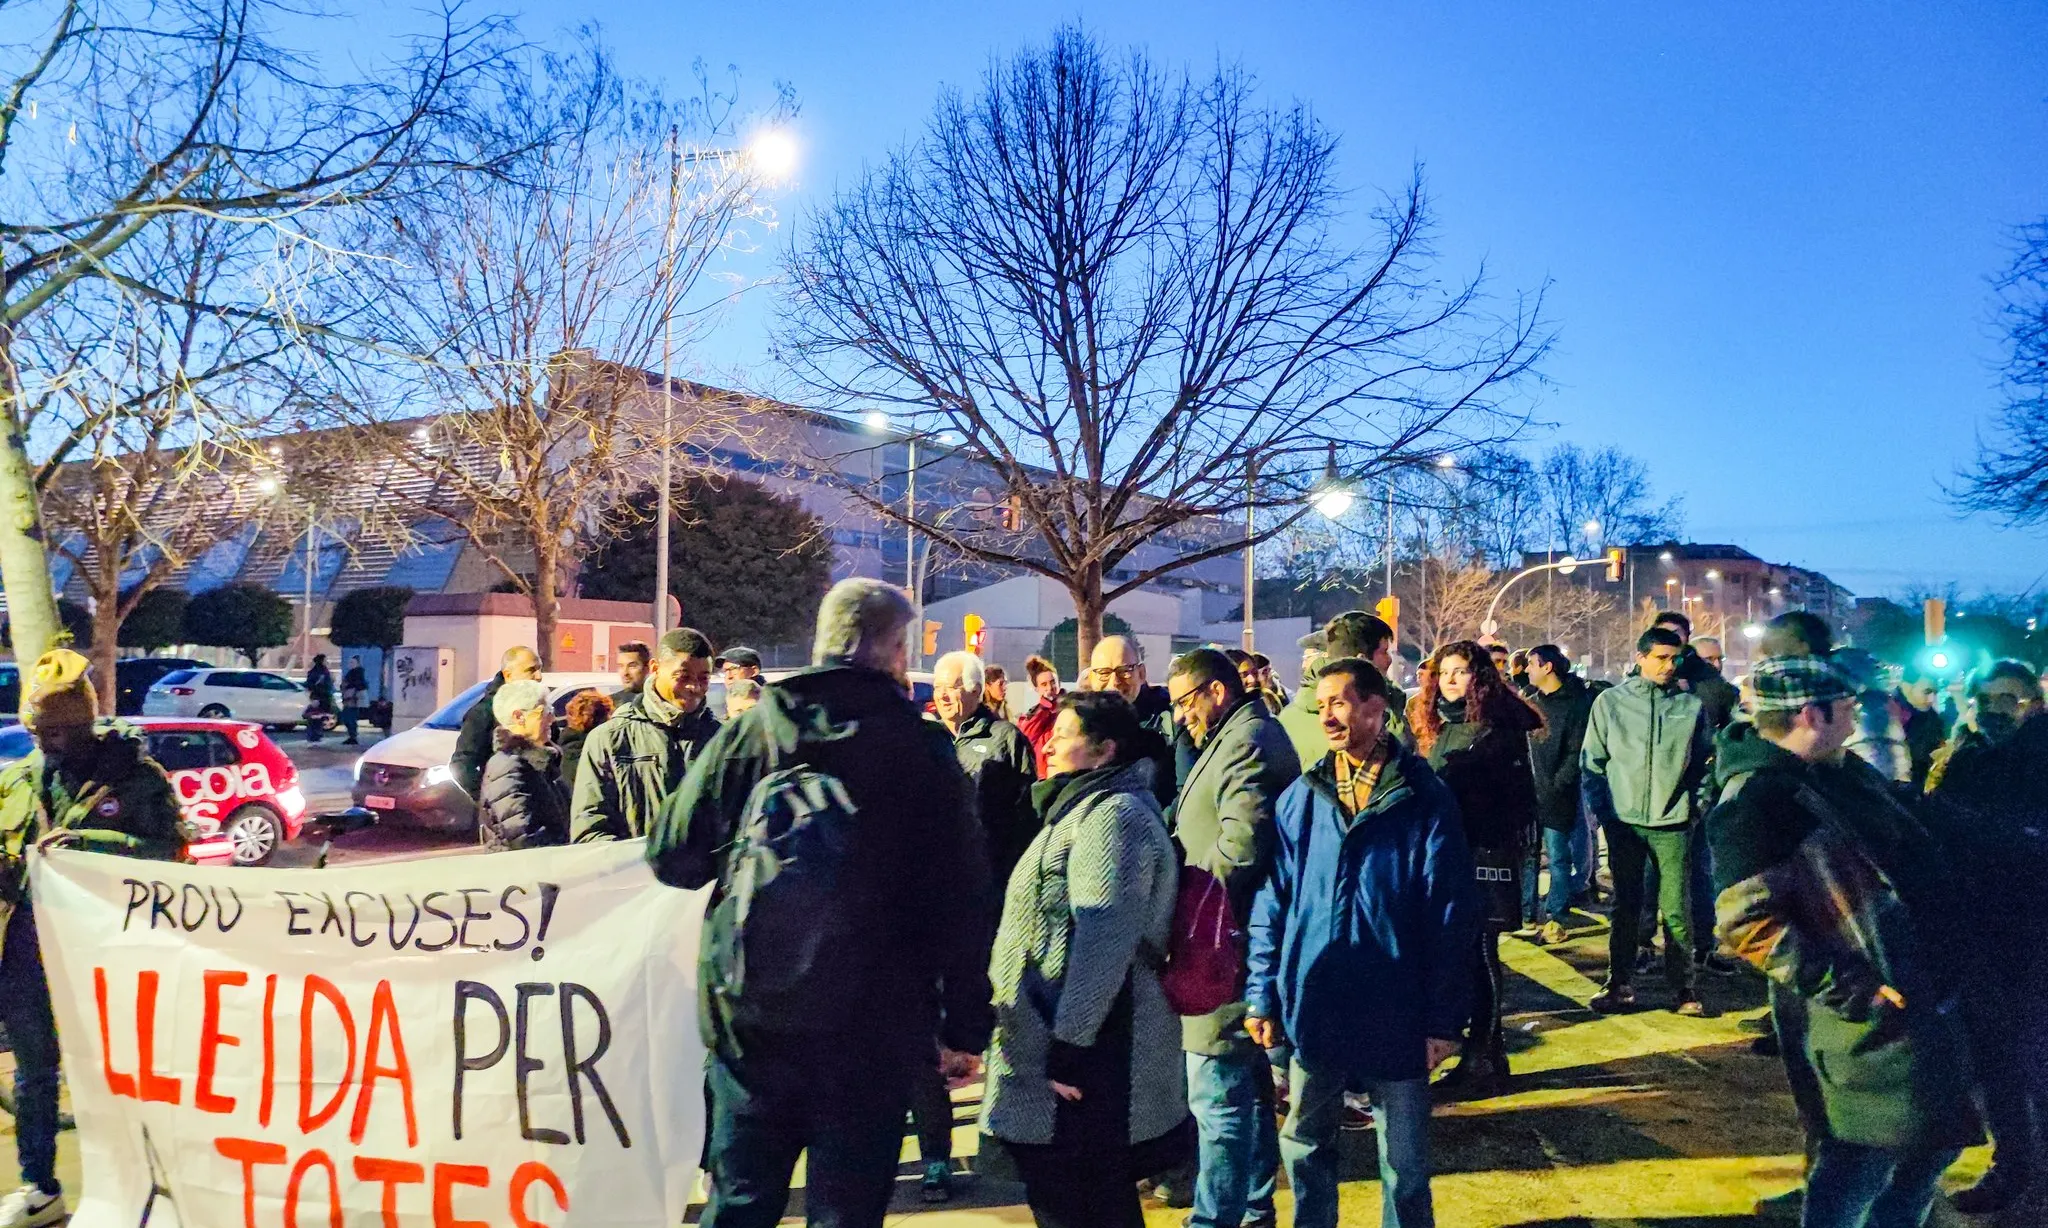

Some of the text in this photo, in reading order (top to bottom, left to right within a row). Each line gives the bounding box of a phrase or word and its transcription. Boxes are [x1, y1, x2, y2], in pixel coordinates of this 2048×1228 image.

[168, 762, 276, 806] cola
[122, 878, 560, 962] PROU EXCUSES!
[94, 967, 631, 1149] LLEIDA PER
